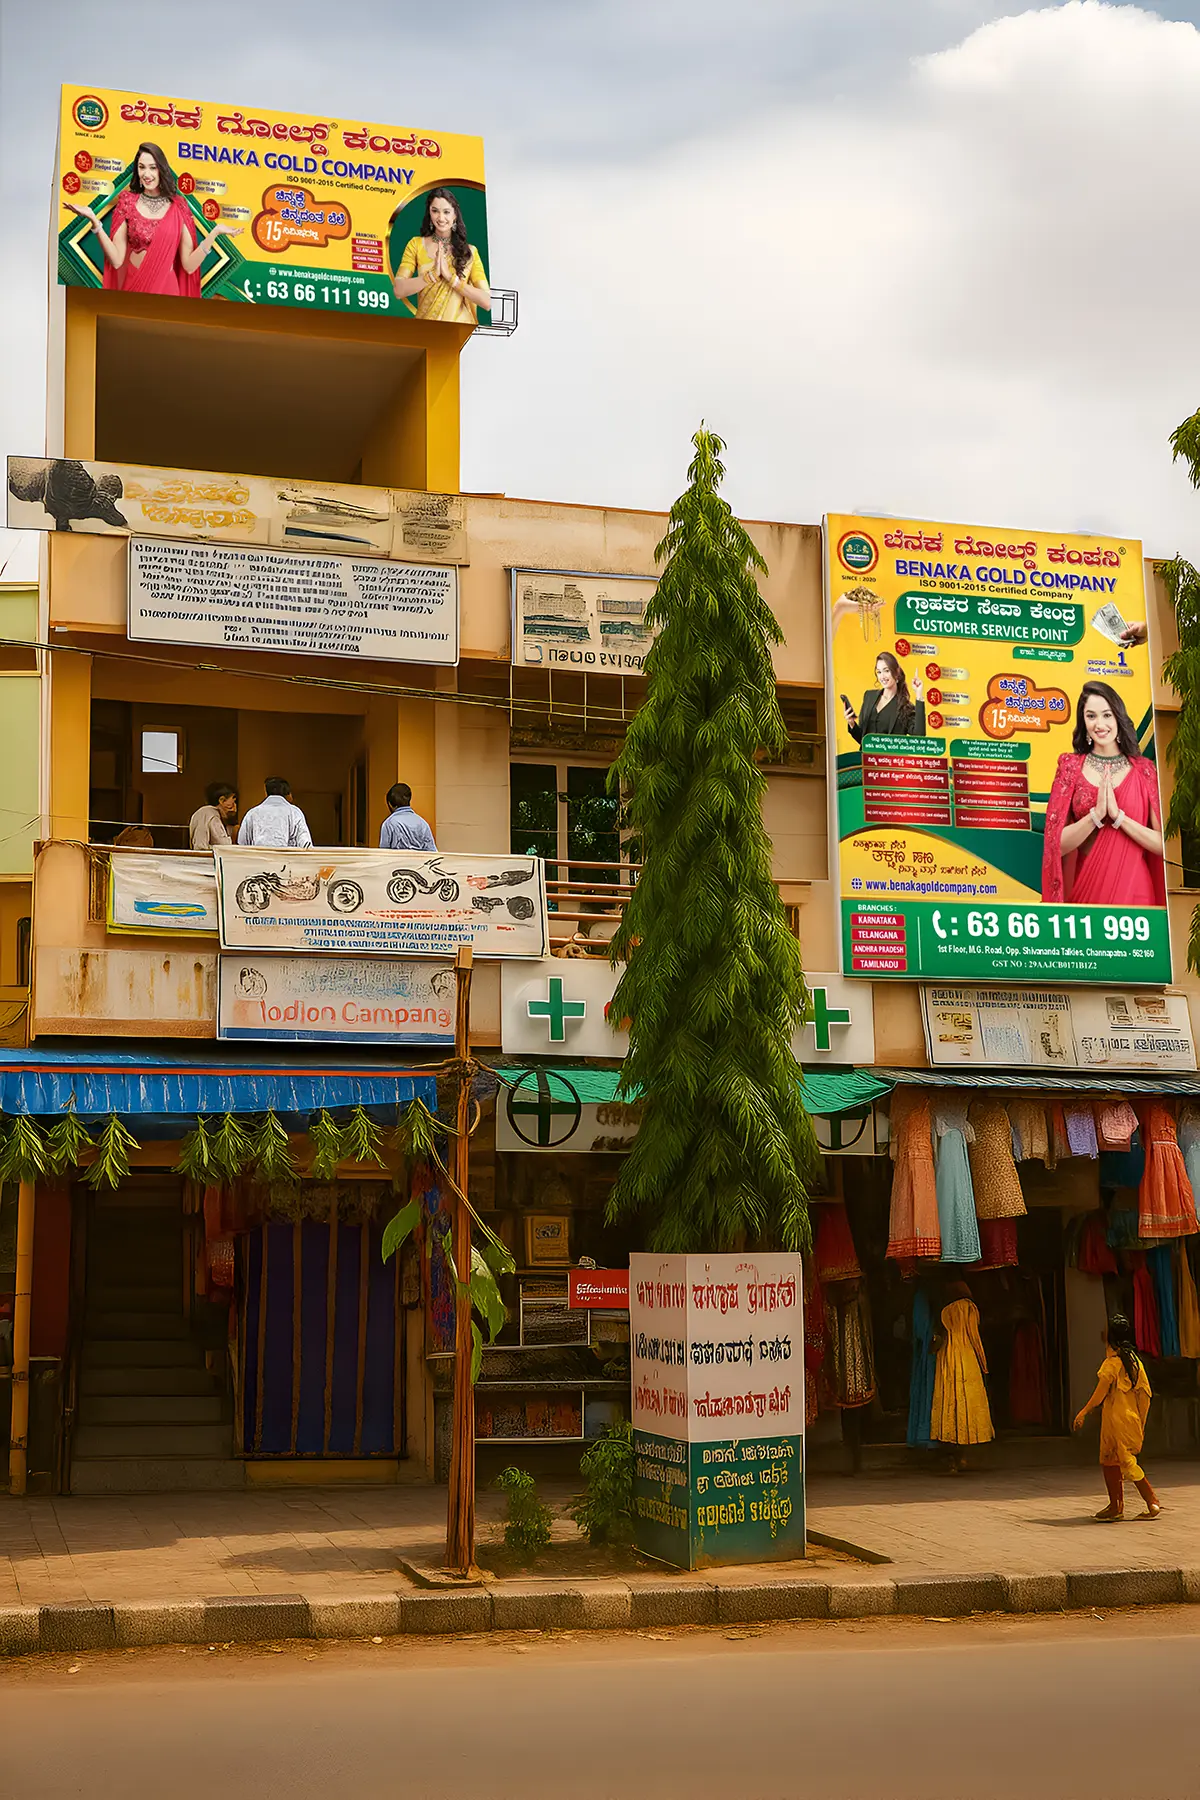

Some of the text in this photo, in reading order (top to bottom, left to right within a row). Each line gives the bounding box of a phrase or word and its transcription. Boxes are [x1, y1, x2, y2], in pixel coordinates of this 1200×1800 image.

[120, 100, 442, 158] ಬೆನಕ ಗೋಲ್ಡ್ ಕಂಪನಿ
[178, 142, 414, 185] BENAKA GOLD COMPANY
[286, 175, 396, 195] ISO 9001-2015 Certified Company
[266, 221, 282, 241] 15
[278, 269, 365, 285] www.benakagoldcompany.com
[267, 281, 289, 299] 63
[294, 284, 316, 302] 66
[320, 287, 351, 305] 111
[358, 290, 390, 309] 999
[883, 529, 1121, 570] ಬೆನಕ ಗೋಲ್ಡ್ ಕಂಪನಿ
[895, 559, 1117, 593] BENAKA GOLD COMPANY
[920, 579, 1074, 600] ISO 9001-2015 Certified Company
[906, 594, 1076, 627] ಗ್ರಾಹಕರ ಸೇವಾ ಕೇಂದ್ರ
[913, 618, 1068, 642] CUSTOMER SERVICE POINT
[1118, 651, 1128, 667] 1
[991, 709, 1007, 729] 15
[866, 879, 998, 896] www.benakagoldcompany.com
[858, 904, 893, 912] BRANCHES
[858, 916, 897, 925] KARNATAKA
[967, 911, 1000, 937] 63
[1008, 912, 1040, 938] 66
[1048, 914, 1092, 939] 111
[1103, 915, 1150, 941] 999
[858, 931, 898, 939] TELANGANA
[854, 945, 904, 954] ANDHRA PRADESH
[938, 945, 947, 953] 1st
[985, 945, 1004, 955] Road,
[1006, 946, 1021, 956] Opp.
[1022, 946, 1060, 956] Shivananda
[860, 960, 899, 969] TAMILNADU
[992, 960, 1008, 968] GST
[1010, 960, 1023, 968] NO
